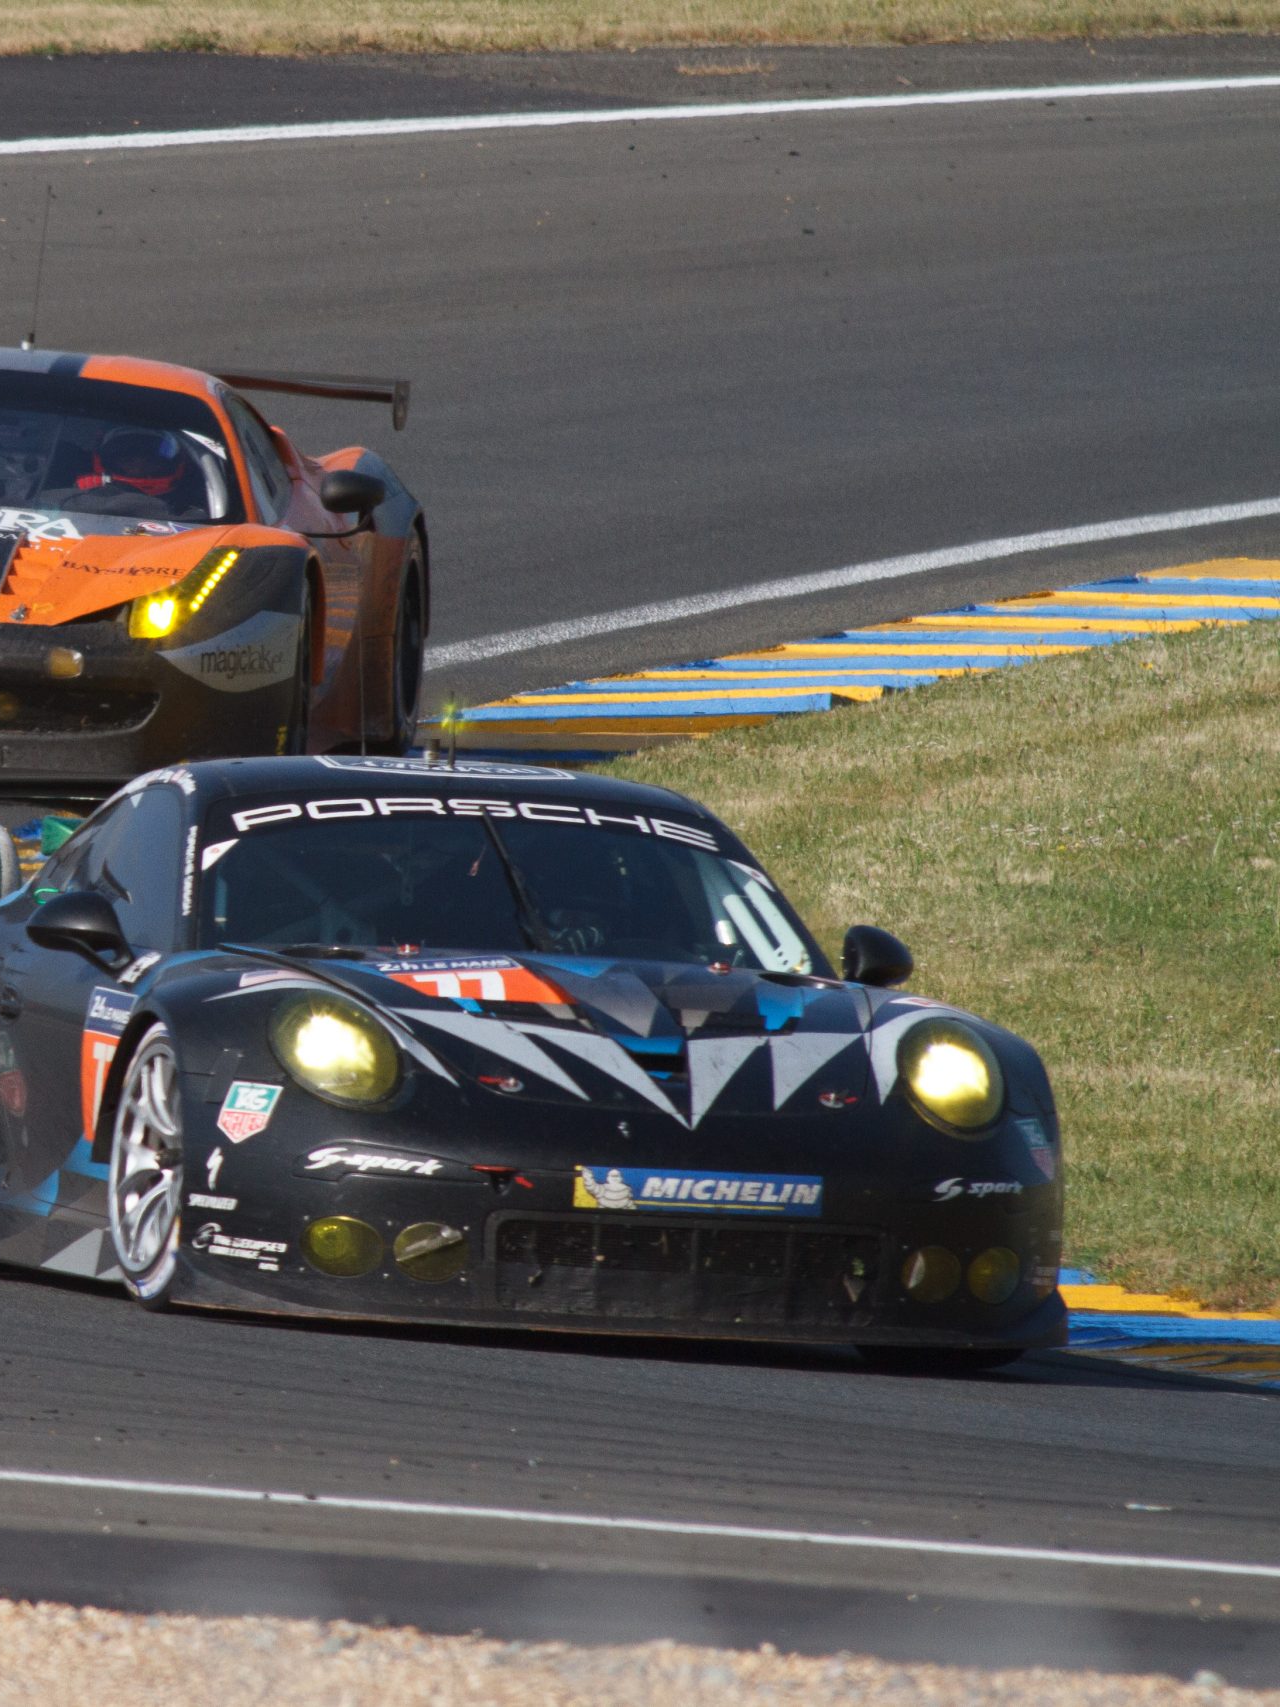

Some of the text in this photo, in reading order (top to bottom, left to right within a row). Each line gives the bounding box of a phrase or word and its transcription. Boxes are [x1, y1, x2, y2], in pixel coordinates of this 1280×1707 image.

[232, 798, 719, 852] PORSCHE
[412, 970, 507, 1001] 77
[640, 1176, 822, 1205] MICHELIN
